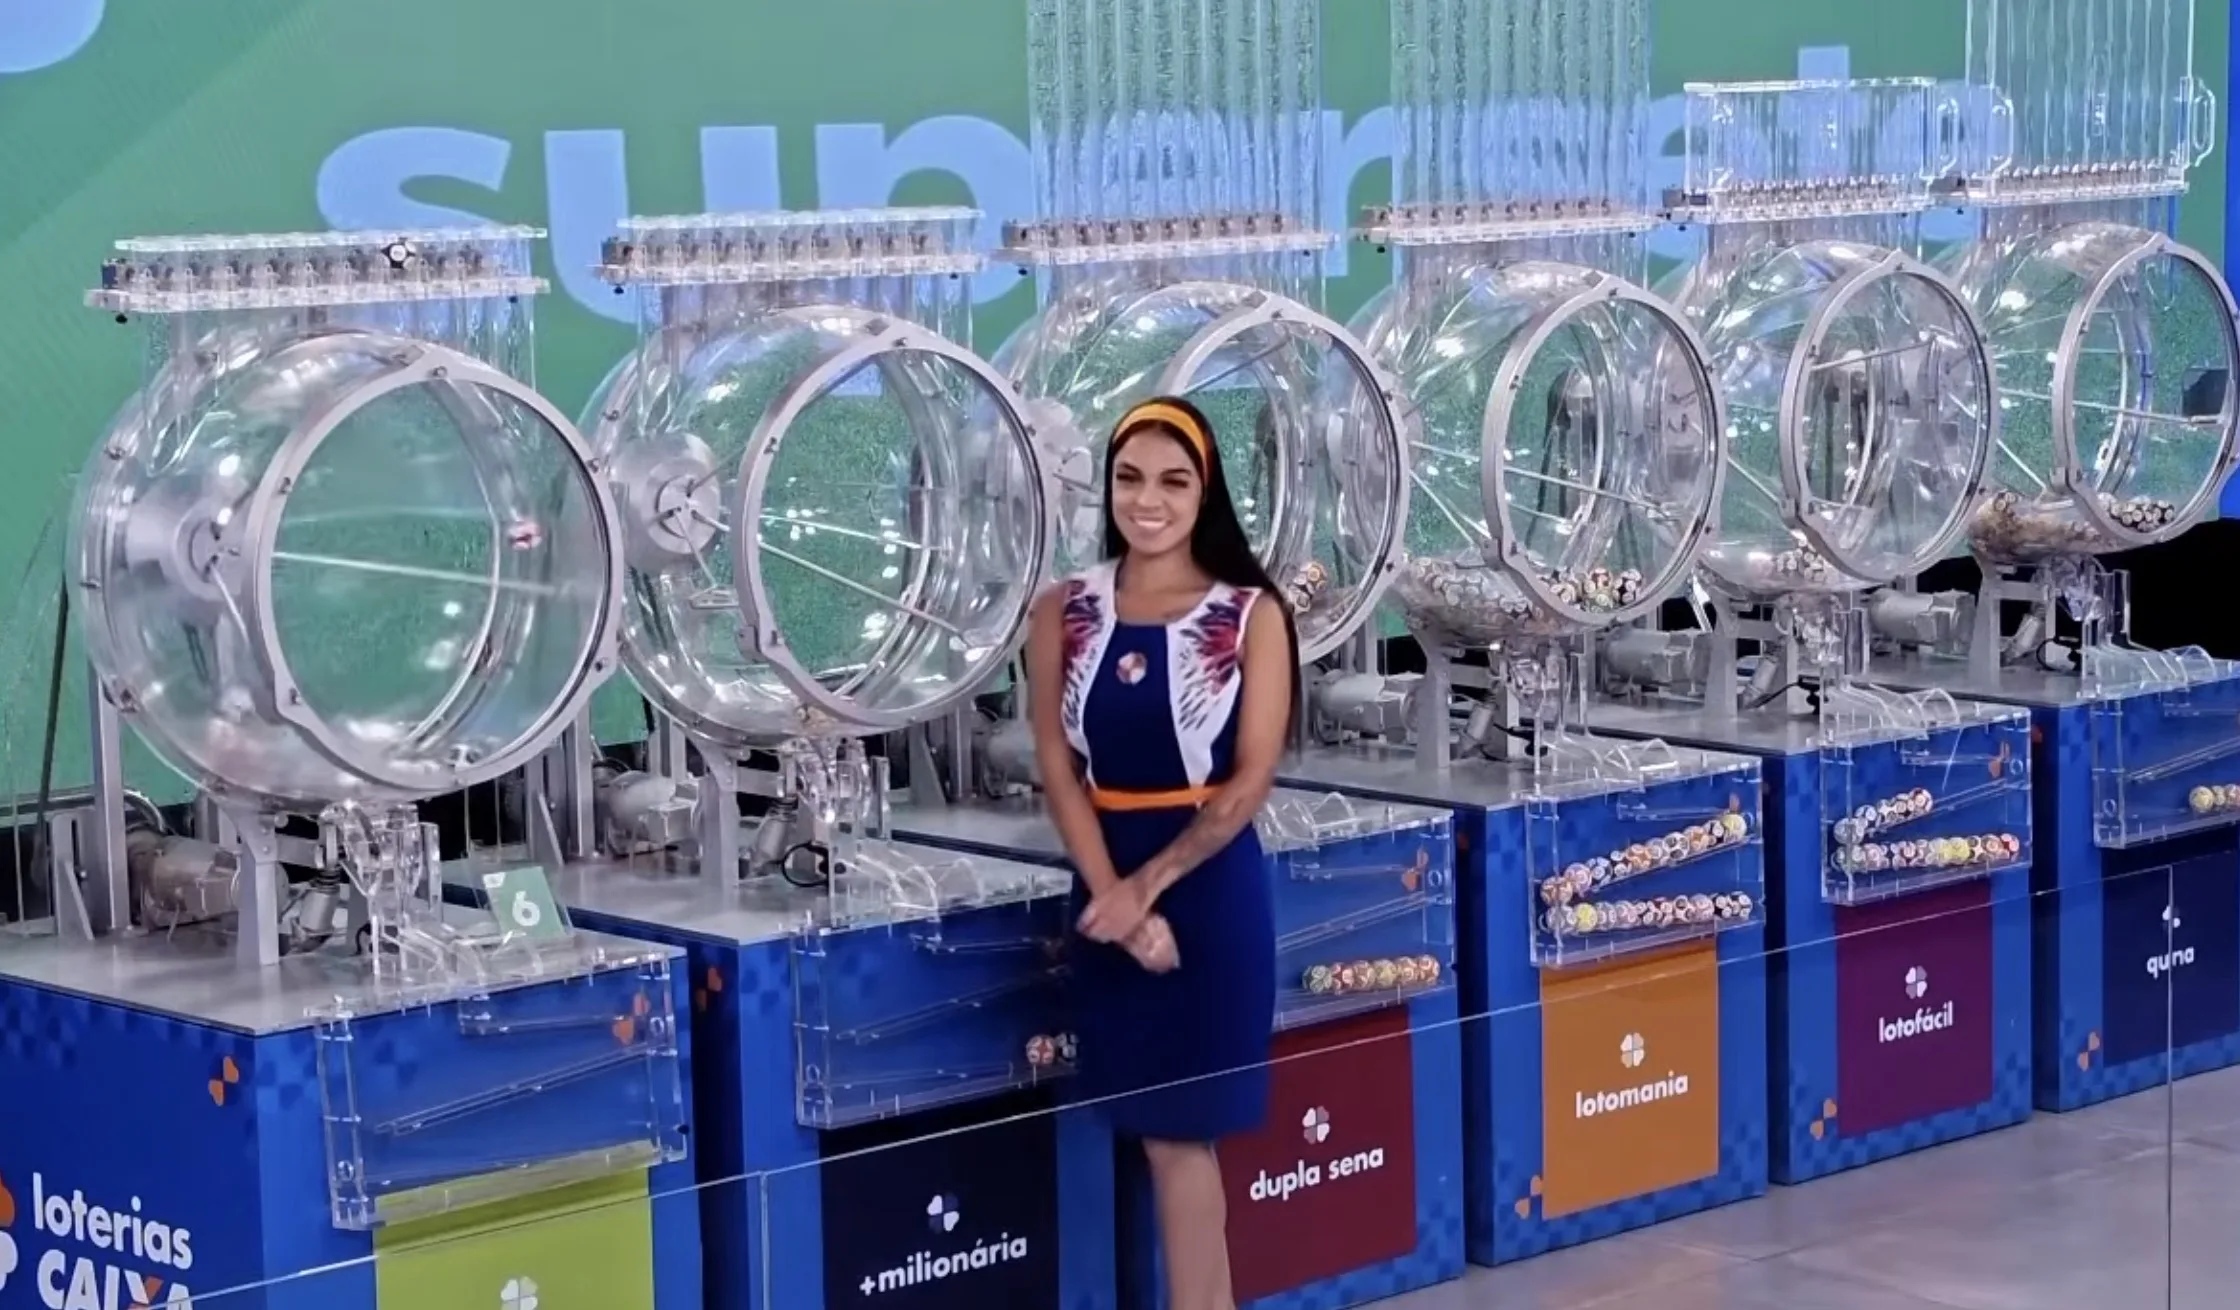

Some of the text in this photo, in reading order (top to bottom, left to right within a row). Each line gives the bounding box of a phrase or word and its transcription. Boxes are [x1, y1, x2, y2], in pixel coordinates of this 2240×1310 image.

[511, 890, 540, 927] 6
[2146, 946, 2195, 979] quna
[1878, 1000, 1953, 1043] lotofácil
[1575, 1069, 1689, 1118] lotomania
[1250, 1148, 1384, 1201] dupla sena
[32, 1171, 194, 1270] loterias
[859, 1231, 1028, 1296] +milionária
